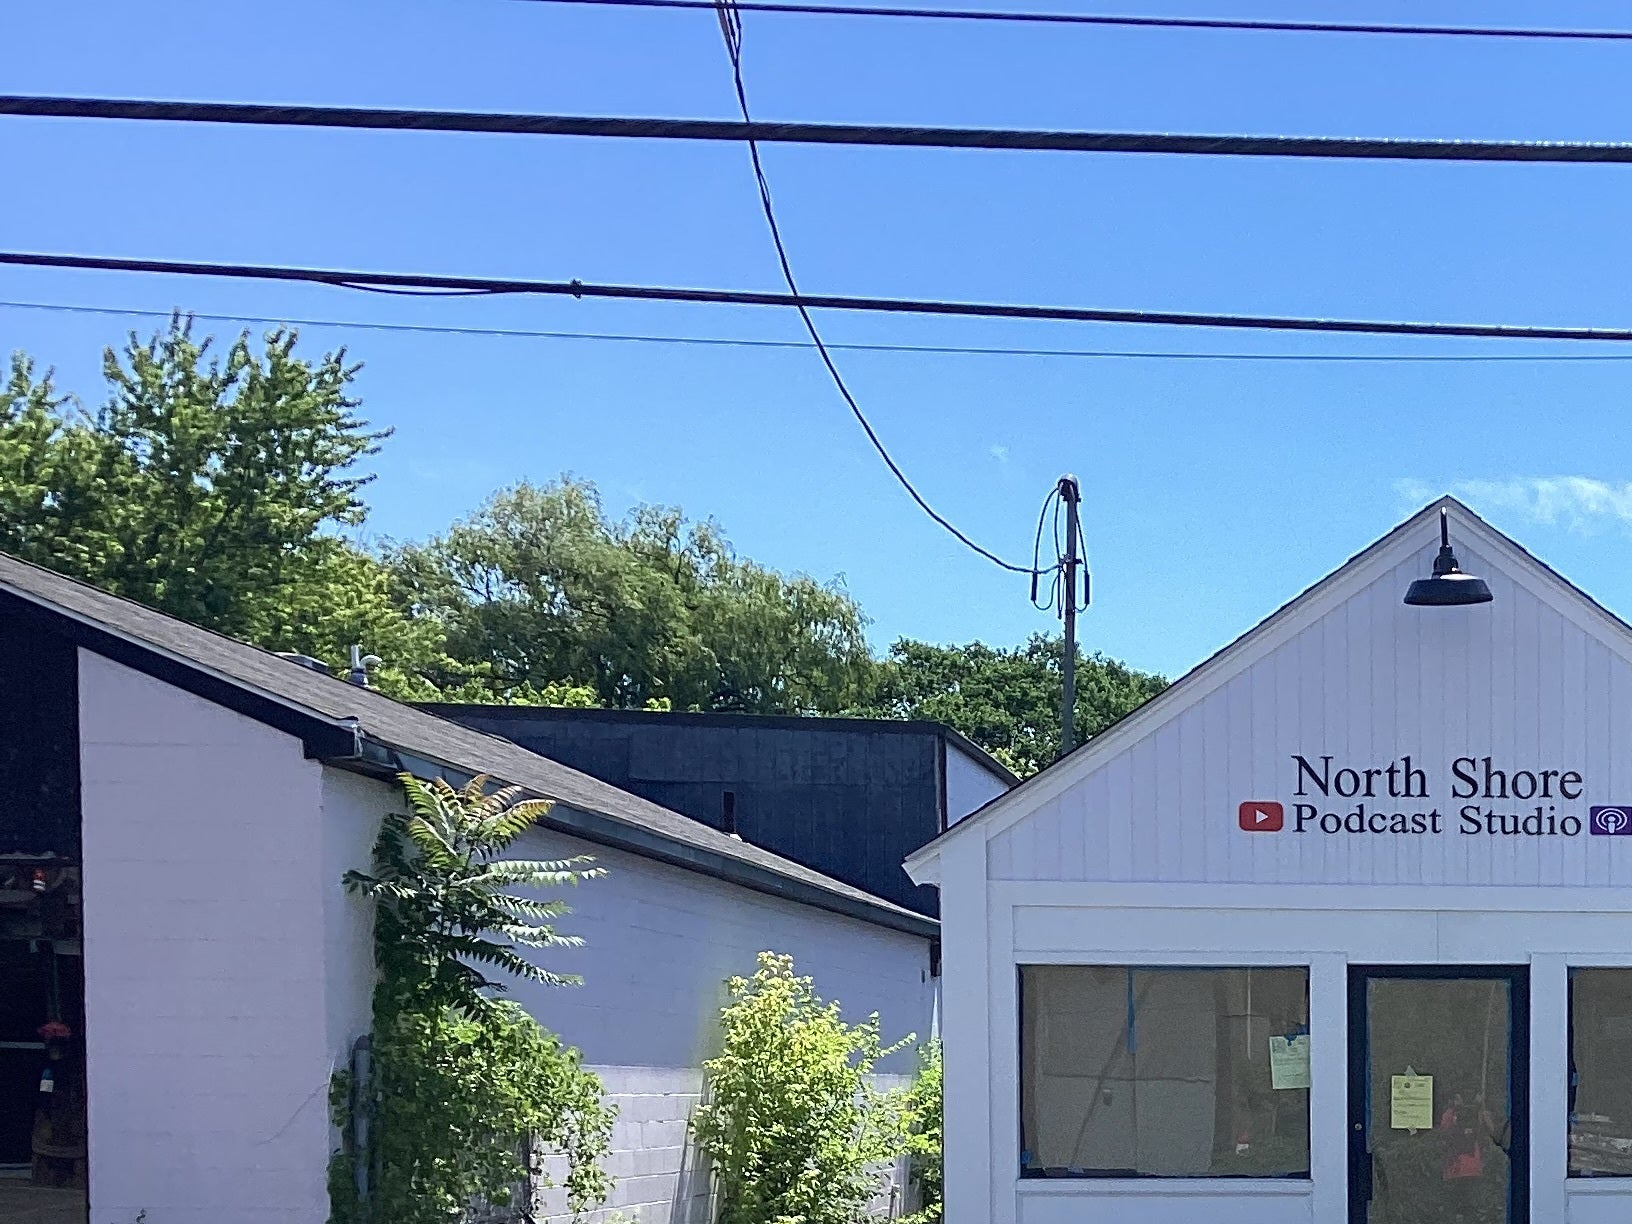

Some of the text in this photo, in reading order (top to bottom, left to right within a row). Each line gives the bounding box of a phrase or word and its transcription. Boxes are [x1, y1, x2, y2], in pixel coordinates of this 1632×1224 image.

[1290, 755, 1583, 800] North Shore
[1292, 803, 1582, 836] Podcast Studio
